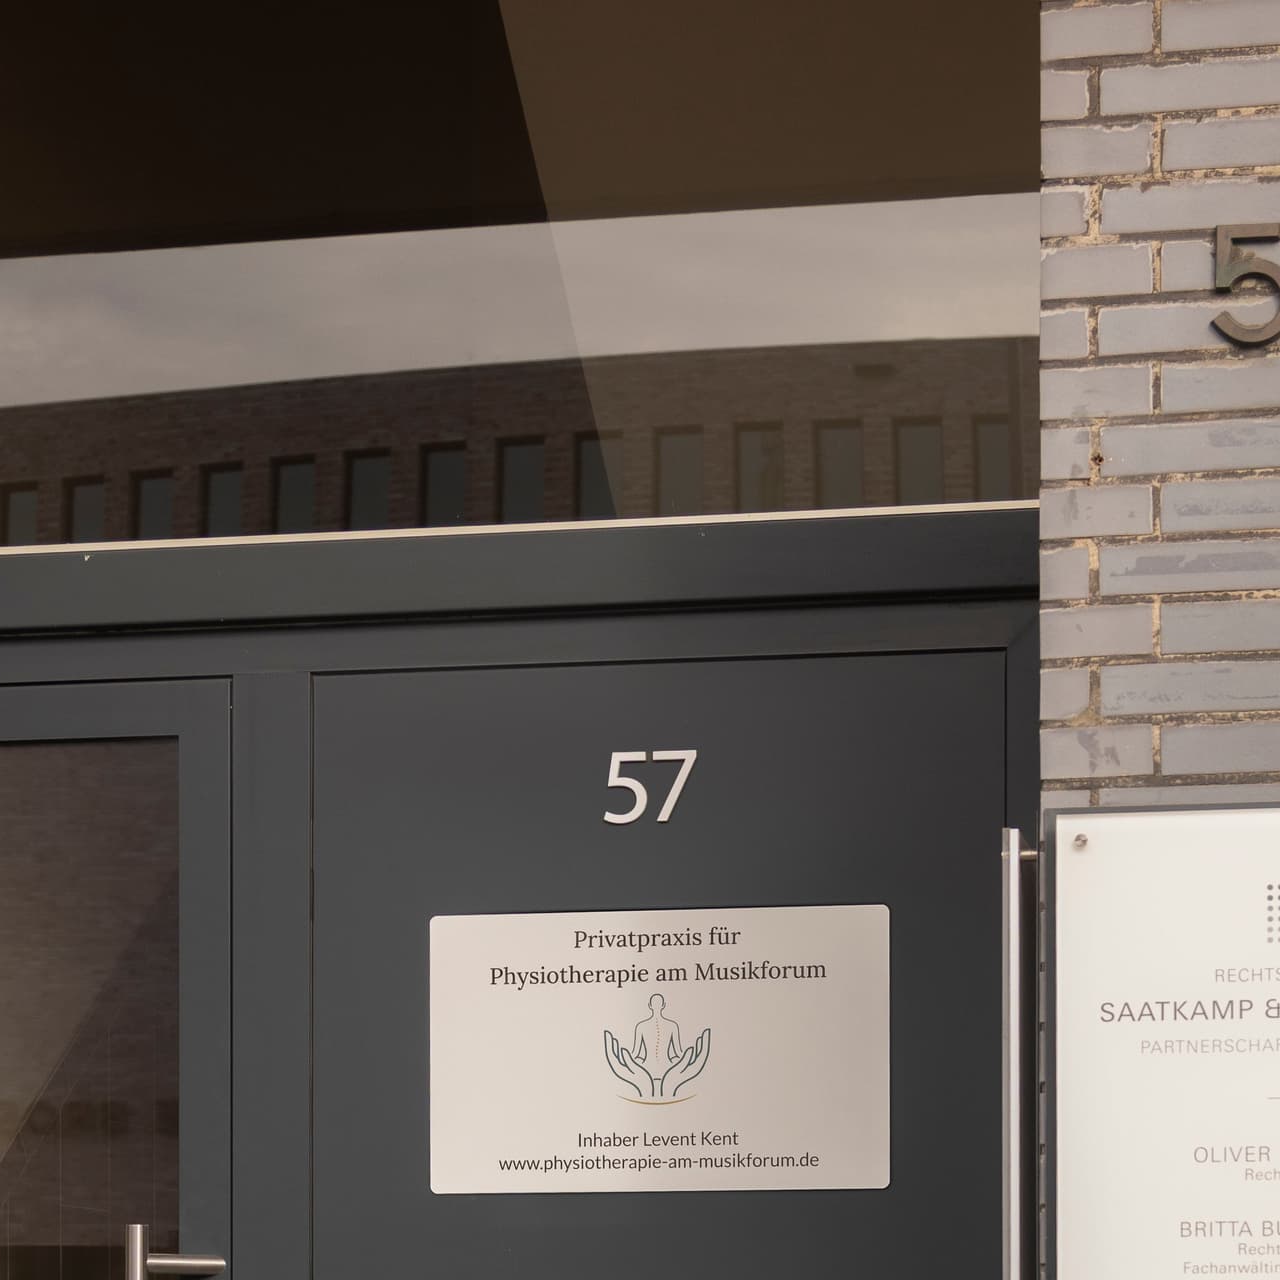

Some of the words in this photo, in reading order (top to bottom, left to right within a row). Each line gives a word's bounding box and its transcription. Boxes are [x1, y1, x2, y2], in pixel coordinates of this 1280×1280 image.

[603, 749, 697, 824] 57
[574, 927, 703, 953] Privatpraxis
[708, 926, 742, 946] für
[490, 963, 649, 991] Physiotherapie
[655, 967, 688, 982] am
[694, 960, 827, 981] Musikforum
[1100, 999, 1254, 1023] SAATKAMP
[578, 1132, 640, 1148] Inhaber
[643, 1132, 697, 1147] Levent
[701, 1131, 739, 1146] Kent
[498, 1151, 820, 1174] www.physiotherapie-am-musikforum.de
[1193, 1145, 1271, 1164] OLIVER
[1180, 1220, 1253, 1238] BRITTA
